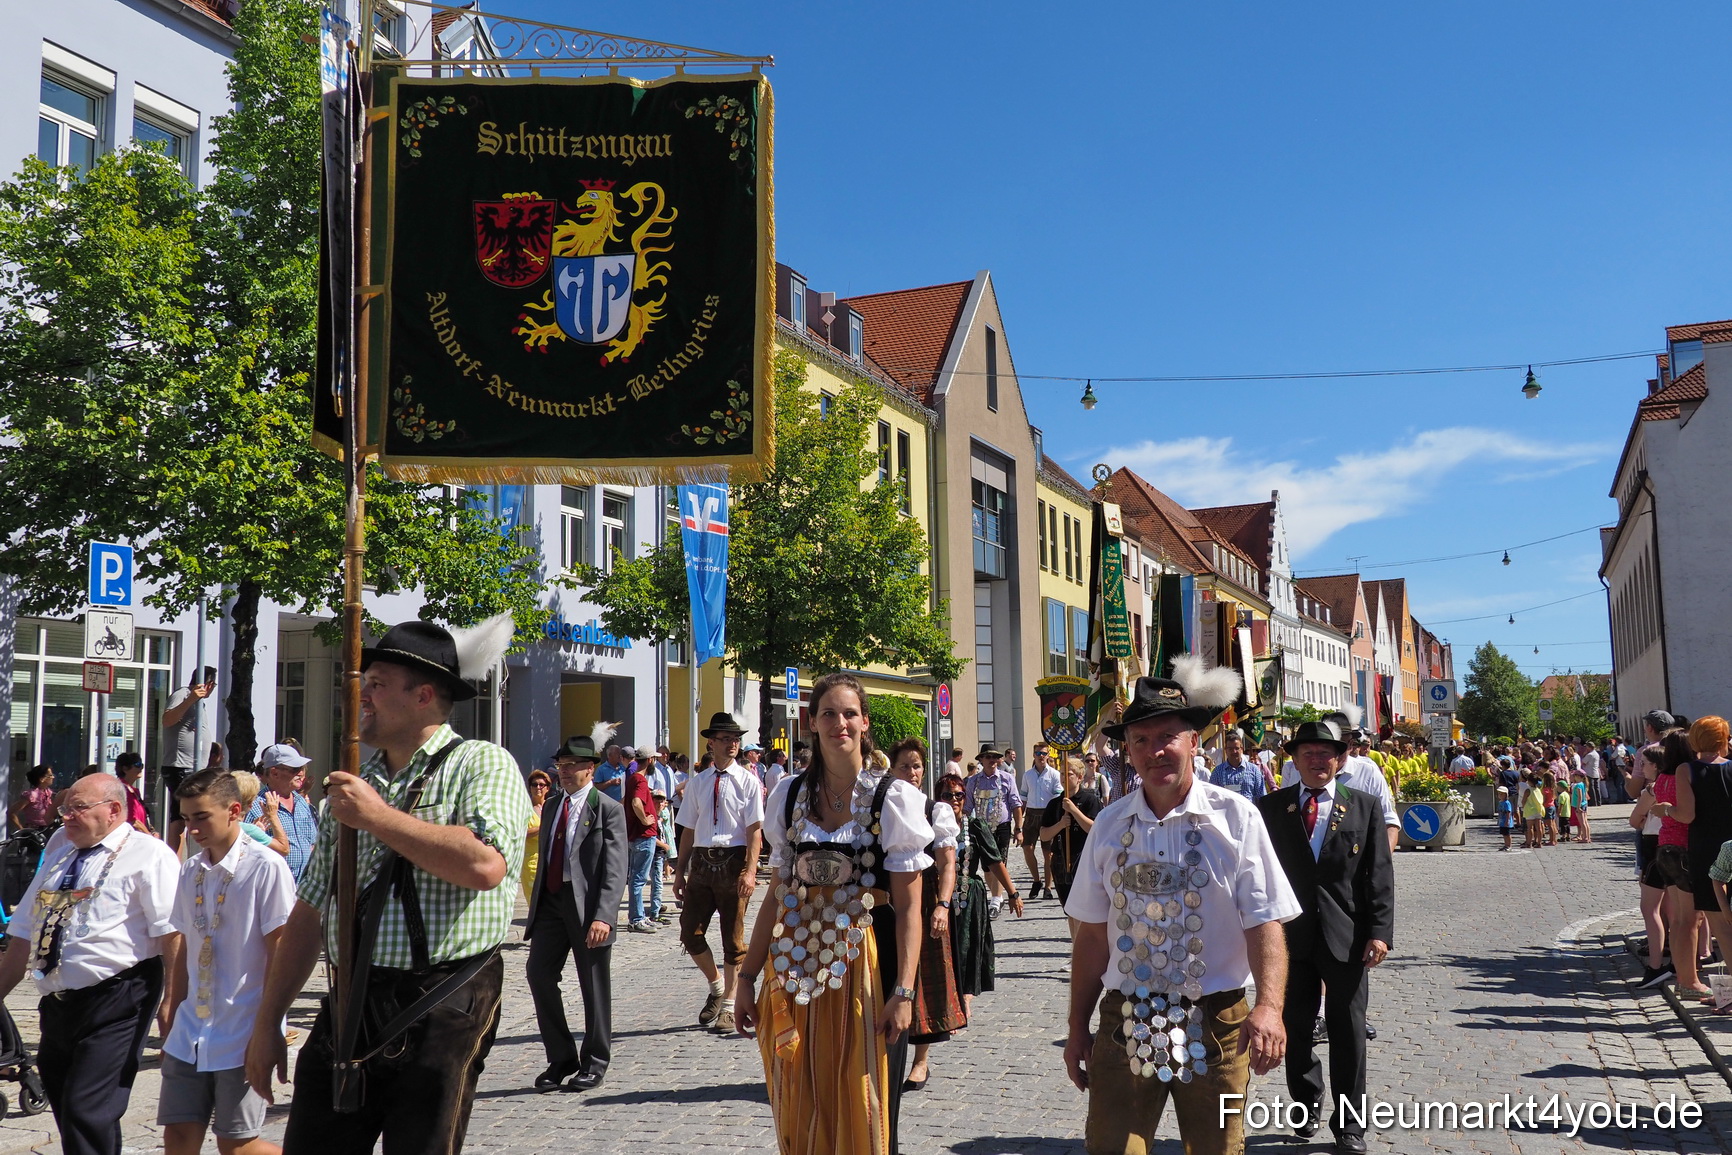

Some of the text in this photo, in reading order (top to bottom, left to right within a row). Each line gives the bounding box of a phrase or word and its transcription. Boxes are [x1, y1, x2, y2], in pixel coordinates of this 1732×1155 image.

[477, 121, 672, 167] Schützengau
[100, 551, 124, 597] P
[103, 615, 119, 625] nur
[788, 671, 796, 696] P
[1047, 684, 1079, 693] BERCHING
